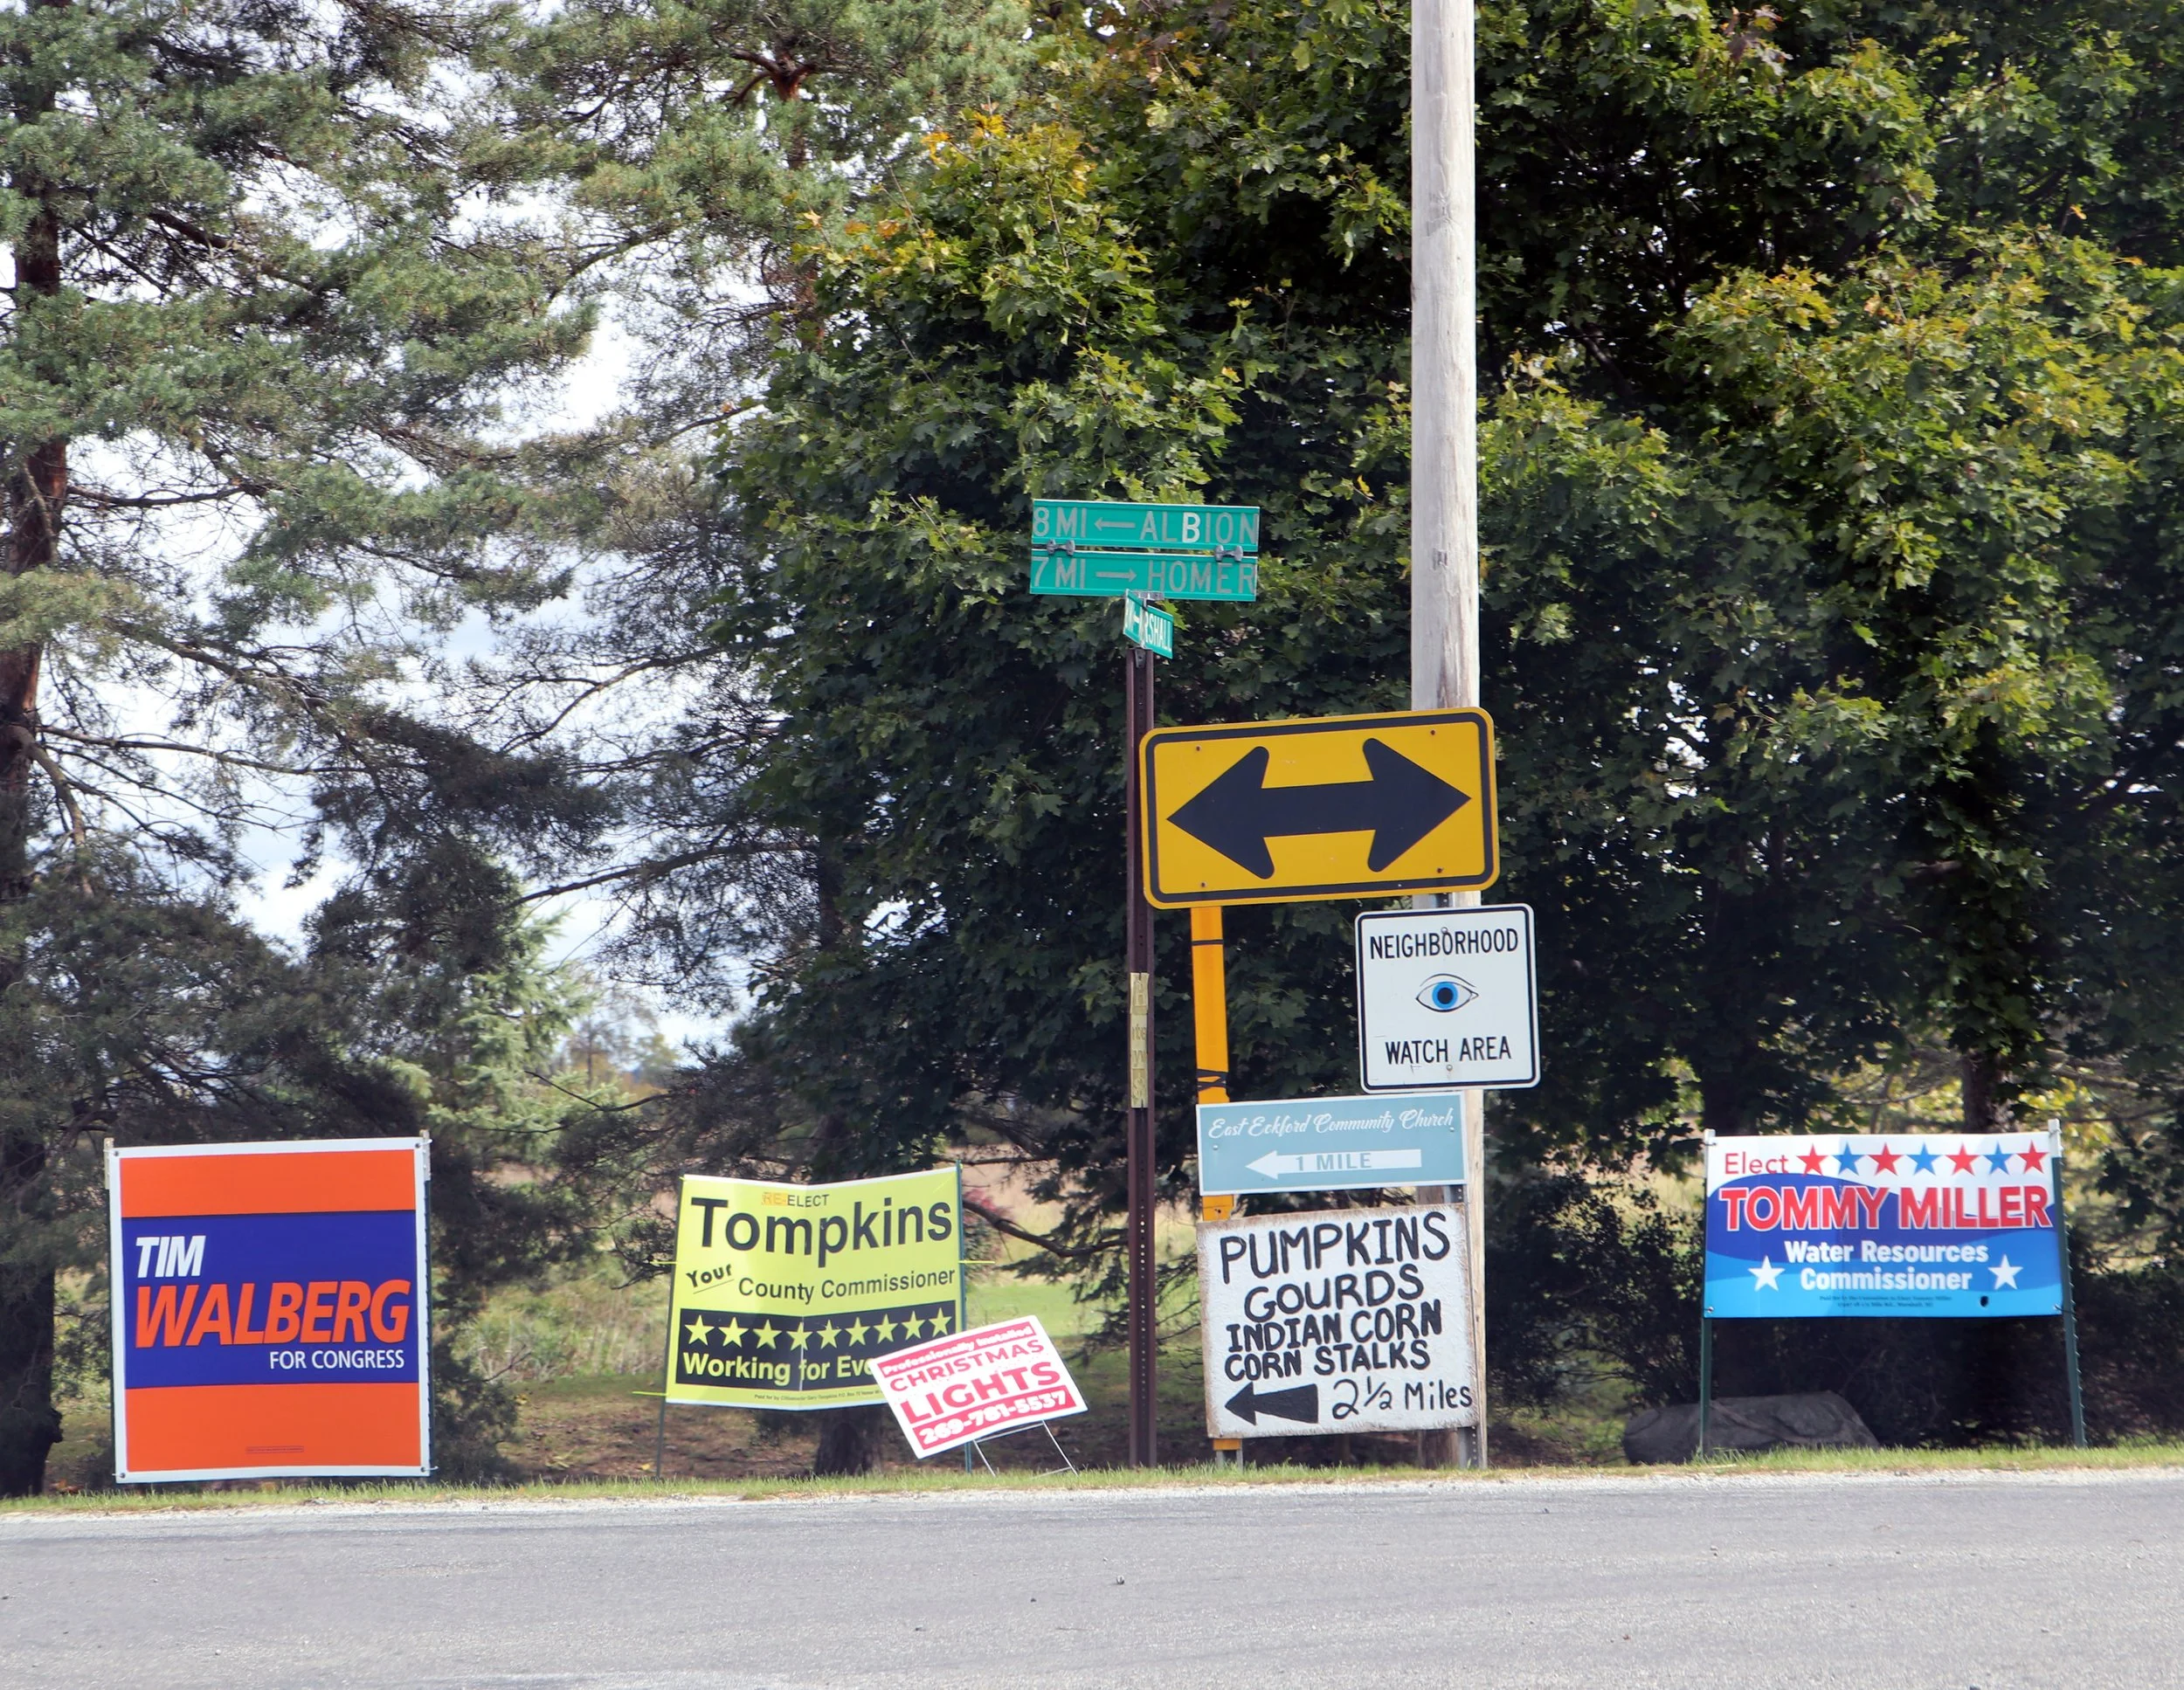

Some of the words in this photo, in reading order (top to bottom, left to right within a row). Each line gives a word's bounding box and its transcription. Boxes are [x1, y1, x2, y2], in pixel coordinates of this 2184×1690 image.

[1033, 507, 1049, 536] 8
[1055, 507, 1087, 538] MI
[1139, 511, 1258, 544] ALBION
[1032, 556, 1048, 587] 7
[1055, 557, 1086, 589] MI
[1147, 560, 1256, 594] HOMER
[1370, 928, 1518, 960] NEIGHBORHOOD
[1386, 1038, 1449, 1065] WATCH
[1459, 1036, 1511, 1061] AREA
[1208, 1118, 1249, 1139] East
[1248, 1114, 1312, 1136] Eckford
[1313, 1110, 1395, 1135] Community
[1400, 1107, 1454, 1130] Church
[1297, 1155, 1304, 1171] 1
[1317, 1152, 1372, 1171] MILE
[1724, 1152, 1789, 1175] Elect
[1719, 1185, 1890, 1231] TOMMY
[1898, 1184, 2053, 1231] MILLER
[691, 1197, 952, 1267] Tompkins
[1220, 1211, 1450, 1284] PUMPKINS
[135, 1235, 206, 1278] TIM
[1784, 1240, 1854, 1263] Water
[1861, 1239, 1989, 1263] Resources
[686, 1264, 732, 1288] Your
[739, 1277, 814, 1305] County
[821, 1269, 956, 1299] Commissioner
[1244, 1263, 1424, 1322] GOURDS
[1800, 1266, 1973, 1290] Commissioner
[135, 1280, 411, 1349] WALBERG
[1227, 1313, 1342, 1353] INDIAN
[1351, 1299, 1442, 1343] CORN
[270, 1350, 306, 1369] FOR
[312, 1349, 404, 1369] CONGRESS
[683, 1352, 791, 1385] Working
[799, 1359, 830, 1380] for
[881, 1340, 975, 1376] Professionally
[889, 1339, 1045, 1391] CHRISTMAS
[1224, 1349, 1302, 1382] CORN
[1314, 1339, 1431, 1376] STALKS
[900, 1362, 1061, 1424] LIGHTS
[1404, 1378, 1473, 1410] Miles
[919, 1390, 1067, 1445] 269-781-5537
